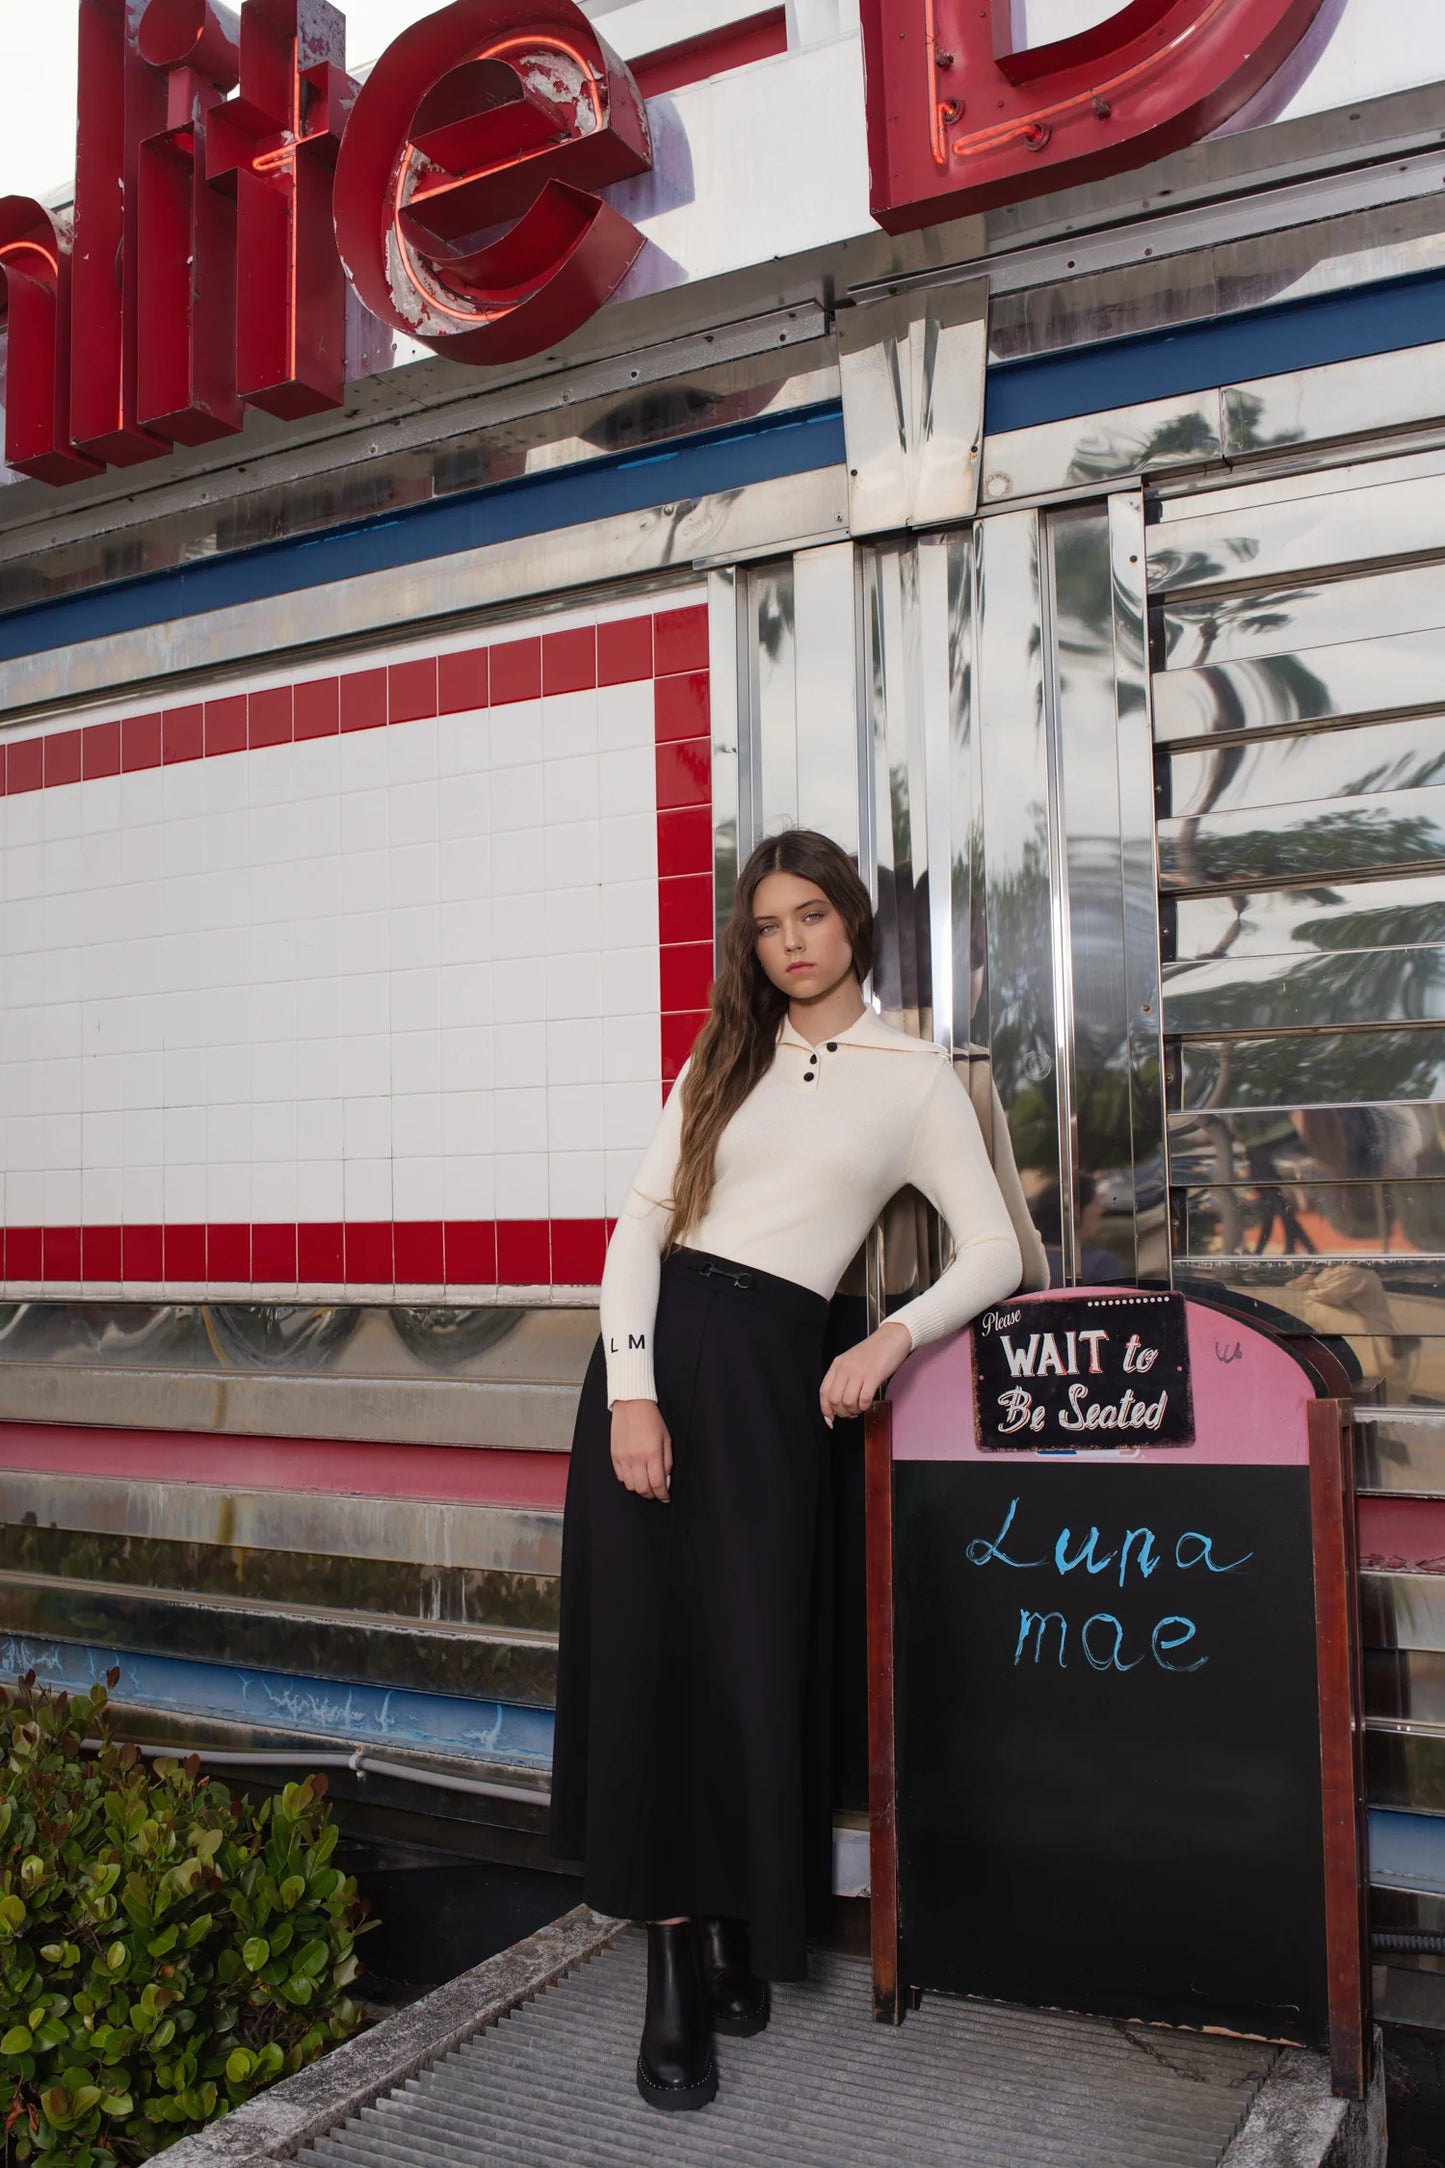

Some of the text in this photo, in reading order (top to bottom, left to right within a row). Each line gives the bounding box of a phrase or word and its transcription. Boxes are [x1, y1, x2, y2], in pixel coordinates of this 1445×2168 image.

[981, 1308, 1022, 1338] Please
[1000, 1329, 1159, 1378] WAIT to
[997, 1382, 1169, 1434] Be Seated
[965, 1496, 1254, 1588] Luna
[1013, 1608, 1210, 1672] mae
